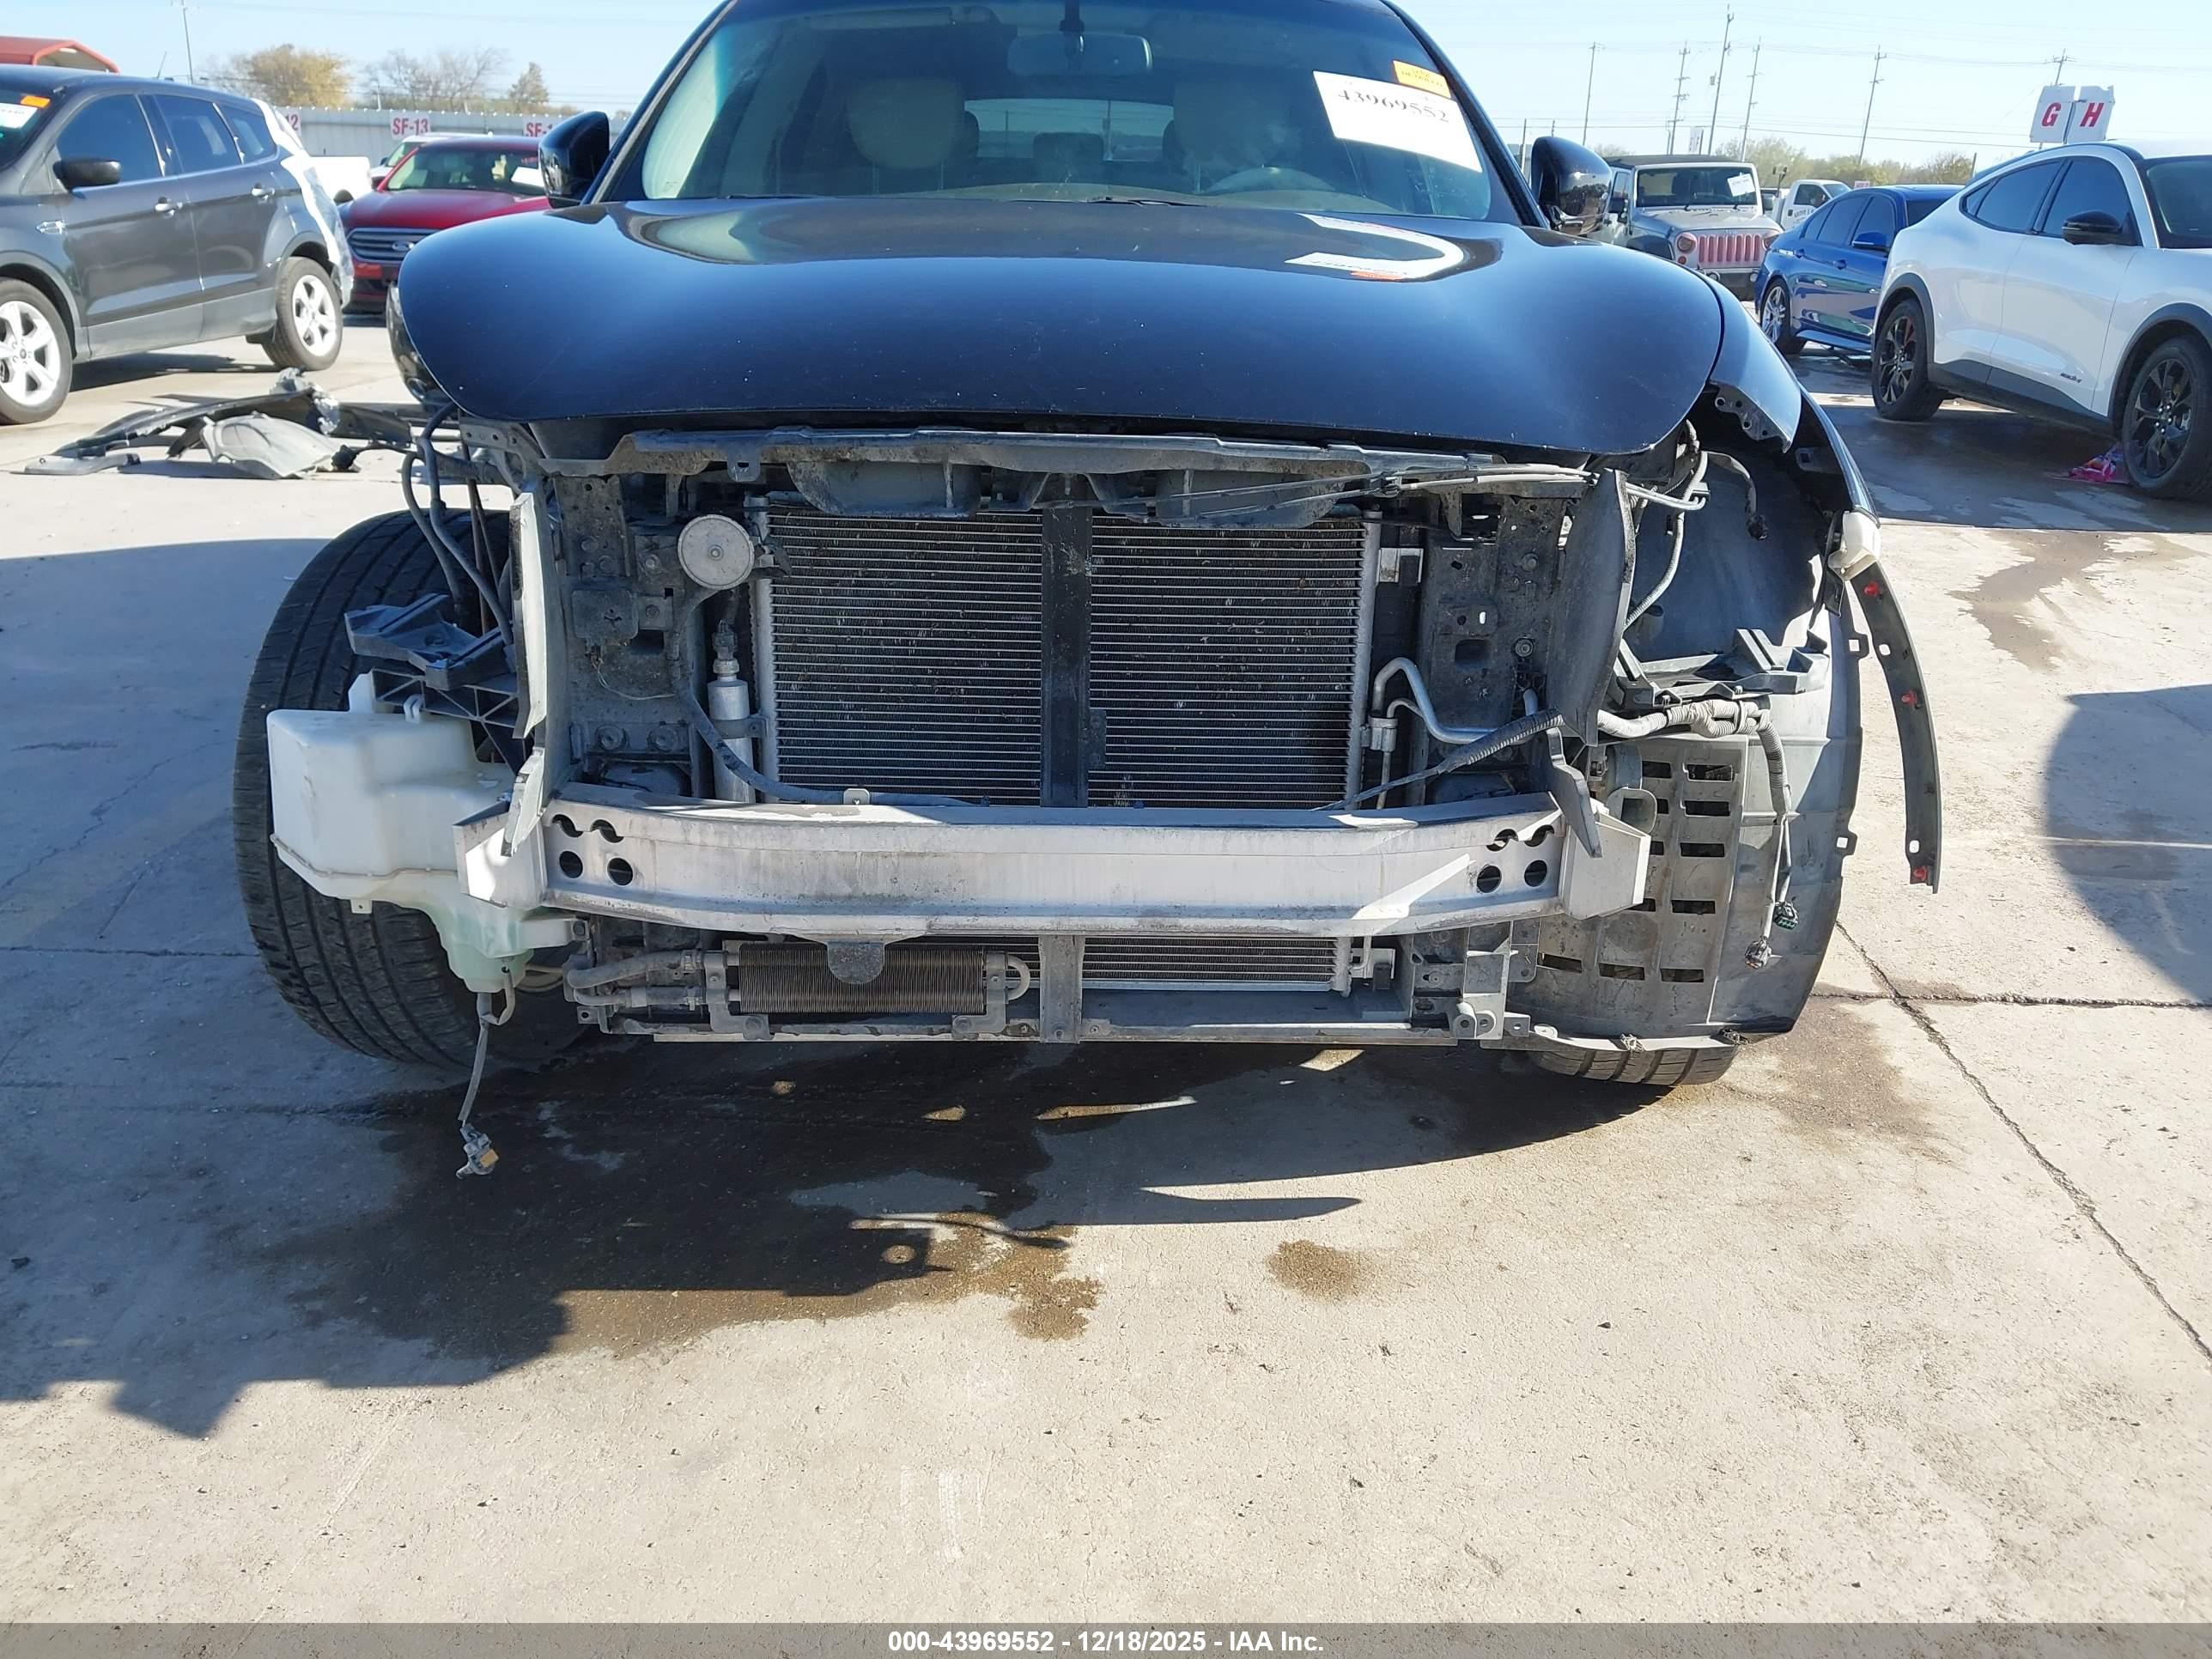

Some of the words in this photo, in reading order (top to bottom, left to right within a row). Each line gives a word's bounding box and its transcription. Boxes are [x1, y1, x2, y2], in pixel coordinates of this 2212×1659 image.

[1338, 89, 1449, 123] 43969552
[2041, 102, 2062, 127] G
[2079, 102, 2105, 127] H
[392, 118, 428, 136] SF-13
